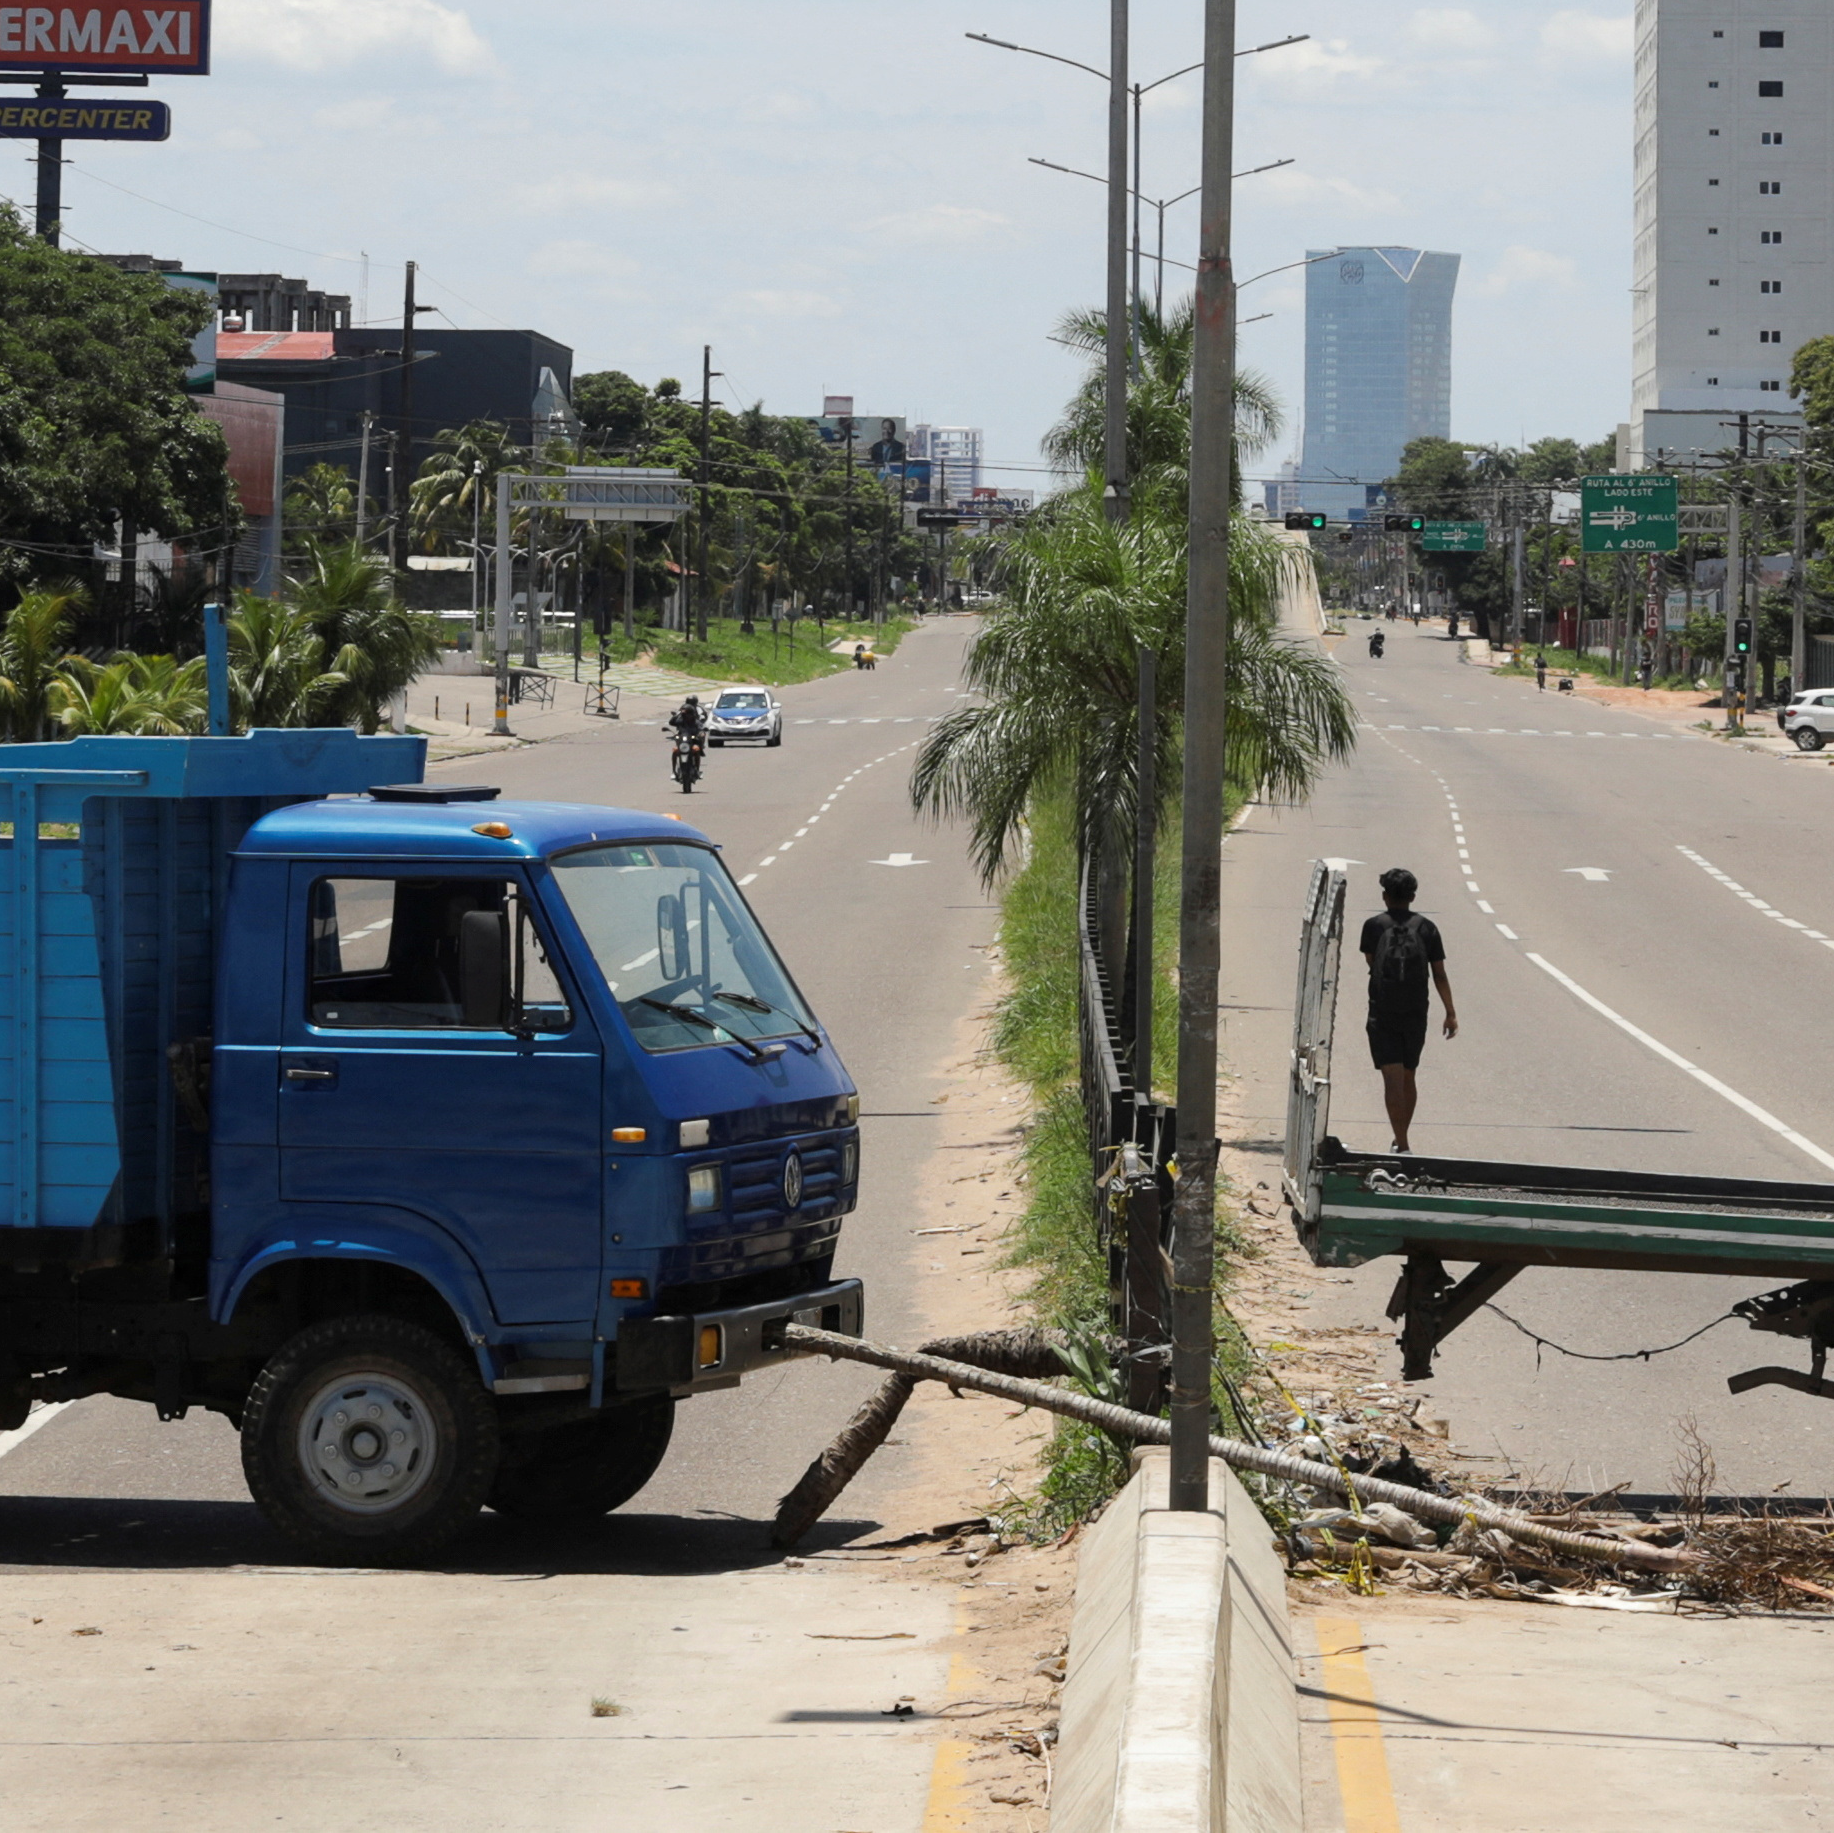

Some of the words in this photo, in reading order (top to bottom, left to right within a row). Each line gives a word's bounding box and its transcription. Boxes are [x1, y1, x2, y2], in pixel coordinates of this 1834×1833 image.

[1639, 478, 1671, 486] ANILLO
[1604, 489, 1629, 497] LADO
[1631, 488, 1653, 496] ESTE
[1604, 540, 1613, 549] A
